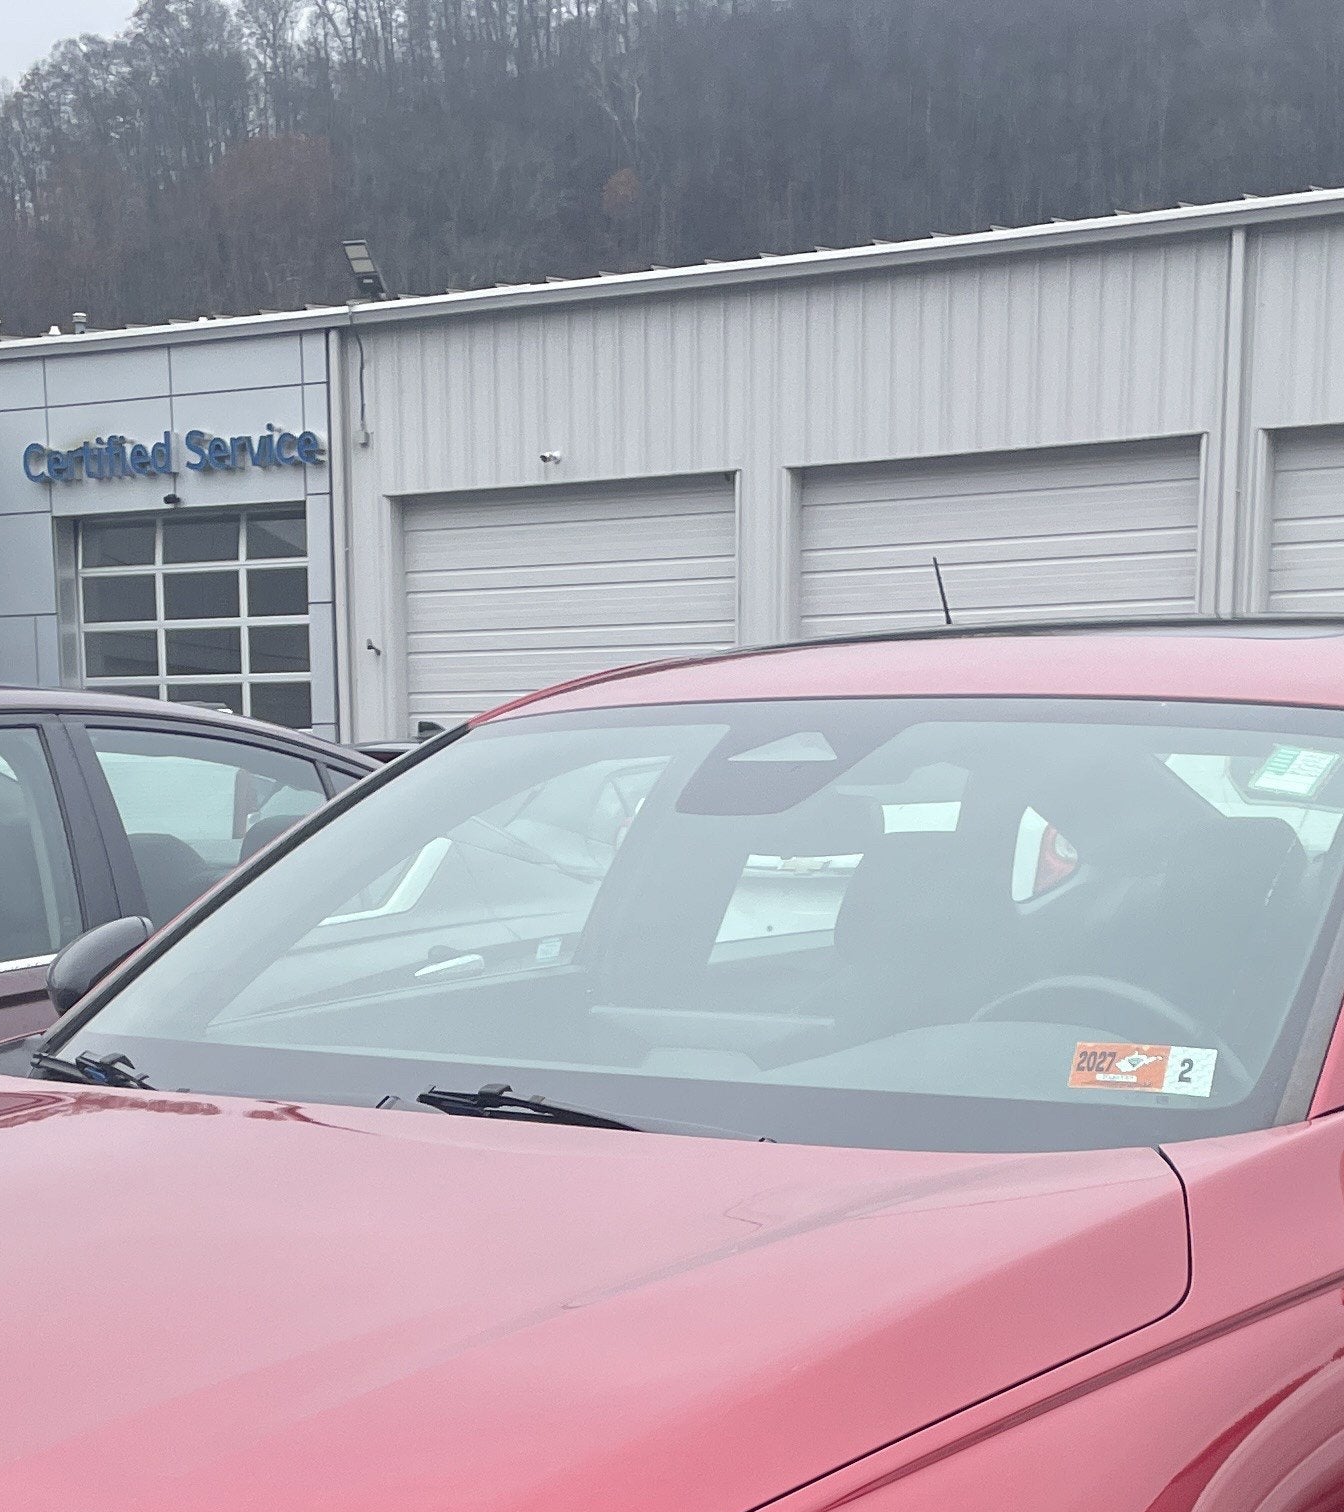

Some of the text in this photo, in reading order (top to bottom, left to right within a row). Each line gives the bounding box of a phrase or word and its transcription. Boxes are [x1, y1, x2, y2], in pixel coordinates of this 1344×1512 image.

[23, 423, 326, 485] Certified Service
[1076, 1050, 1118, 1073] 2027
[1177, 1058, 1195, 1083] 2
